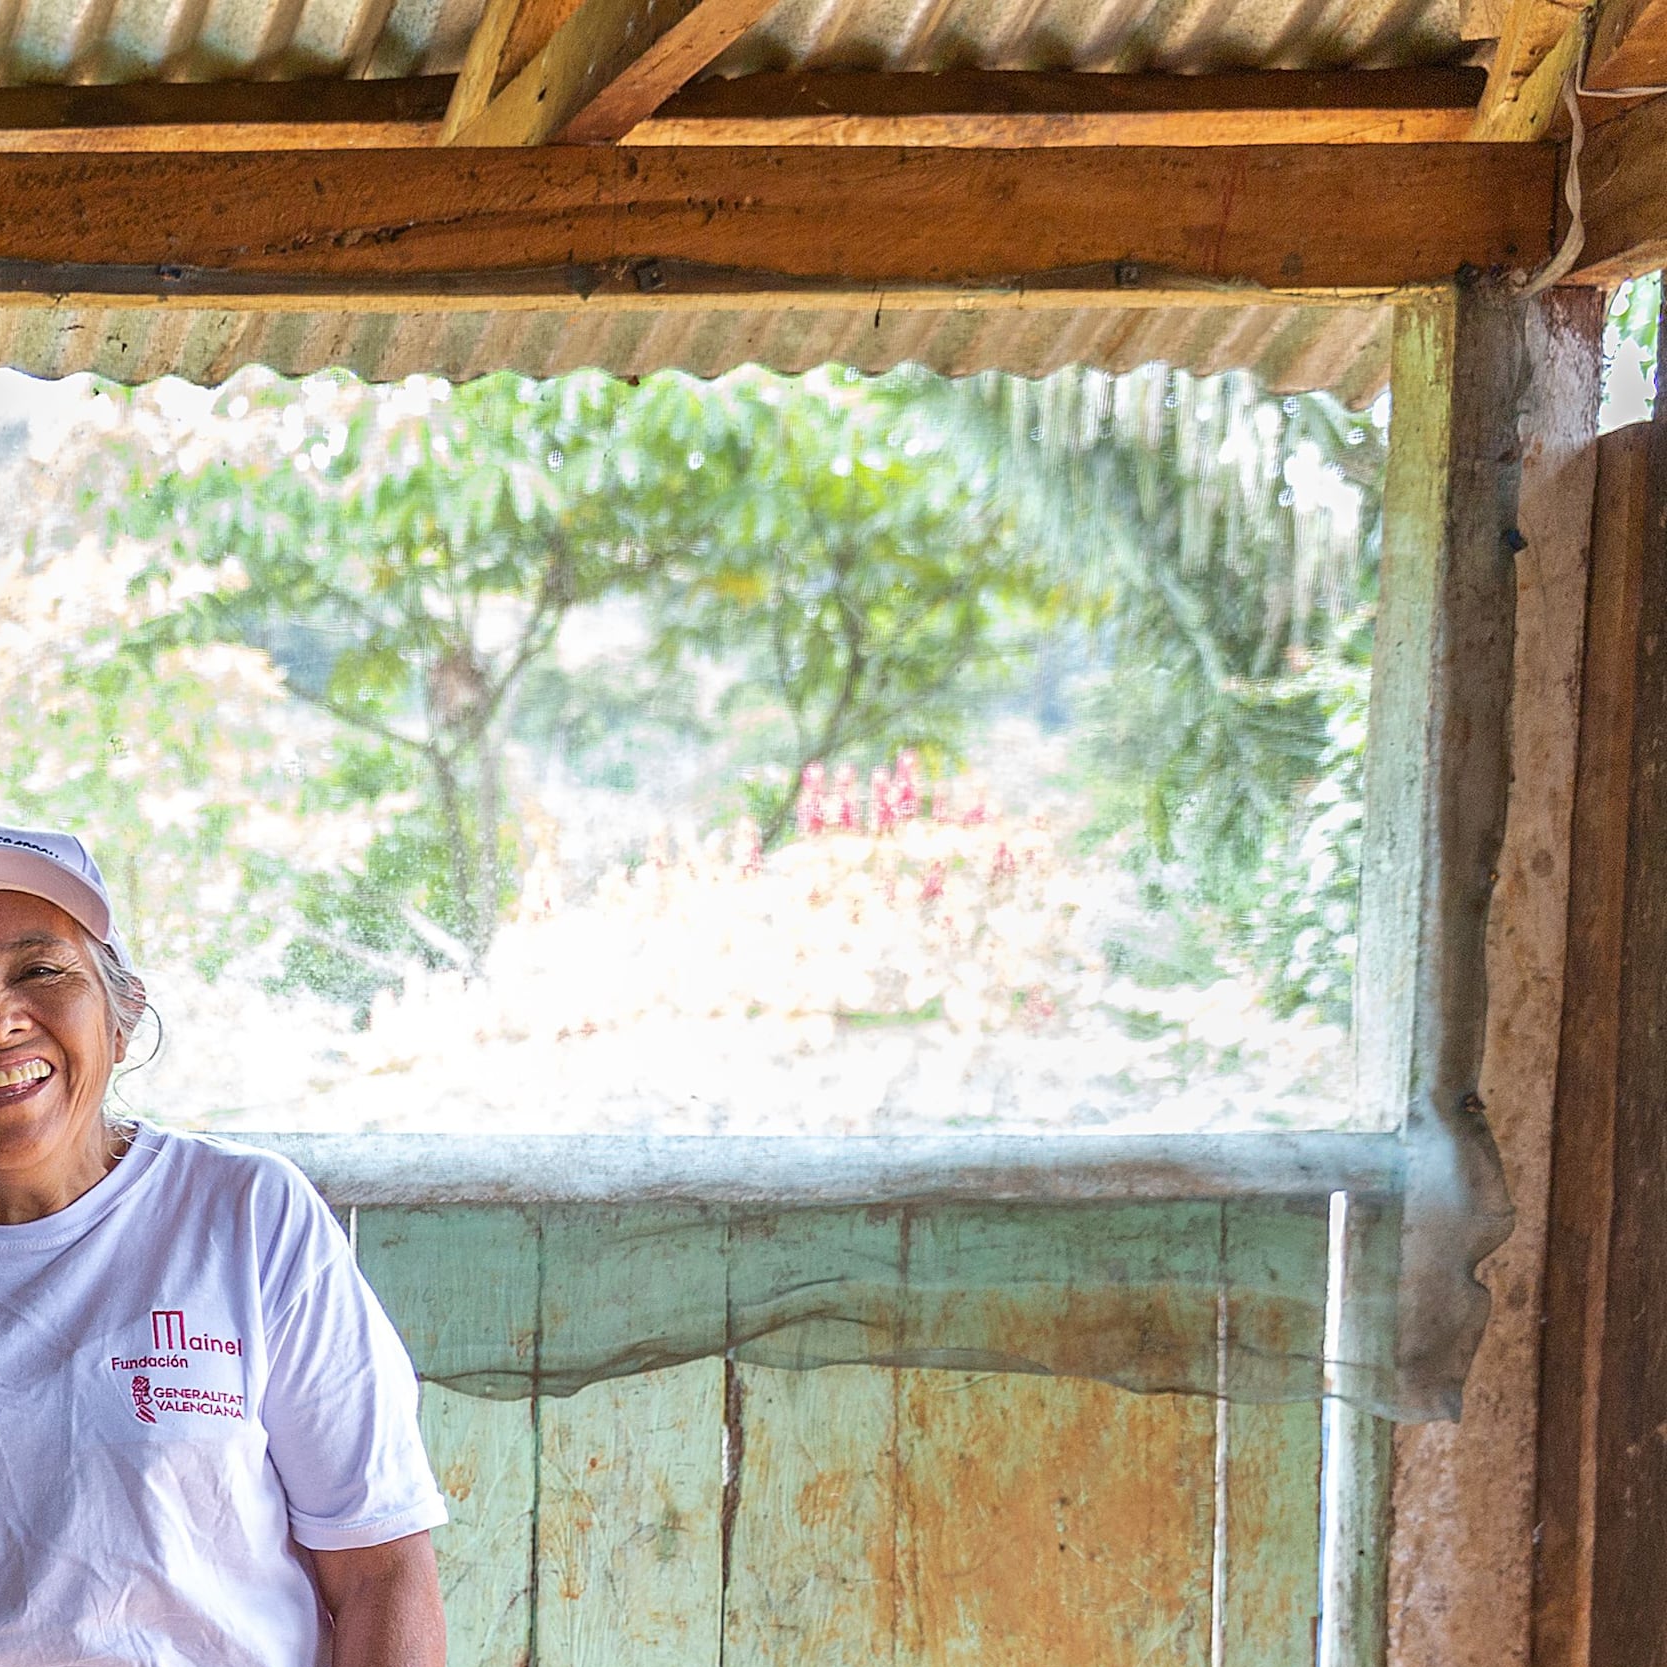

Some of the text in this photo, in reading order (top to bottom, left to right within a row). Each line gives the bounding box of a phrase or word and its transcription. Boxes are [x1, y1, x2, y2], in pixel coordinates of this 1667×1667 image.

[152, 1310, 242, 1357] Mainel
[111, 1354, 188, 1371] Fundación
[153, 1387, 244, 1406] GENERALITAT
[155, 1400, 244, 1420] VALENCIANA
